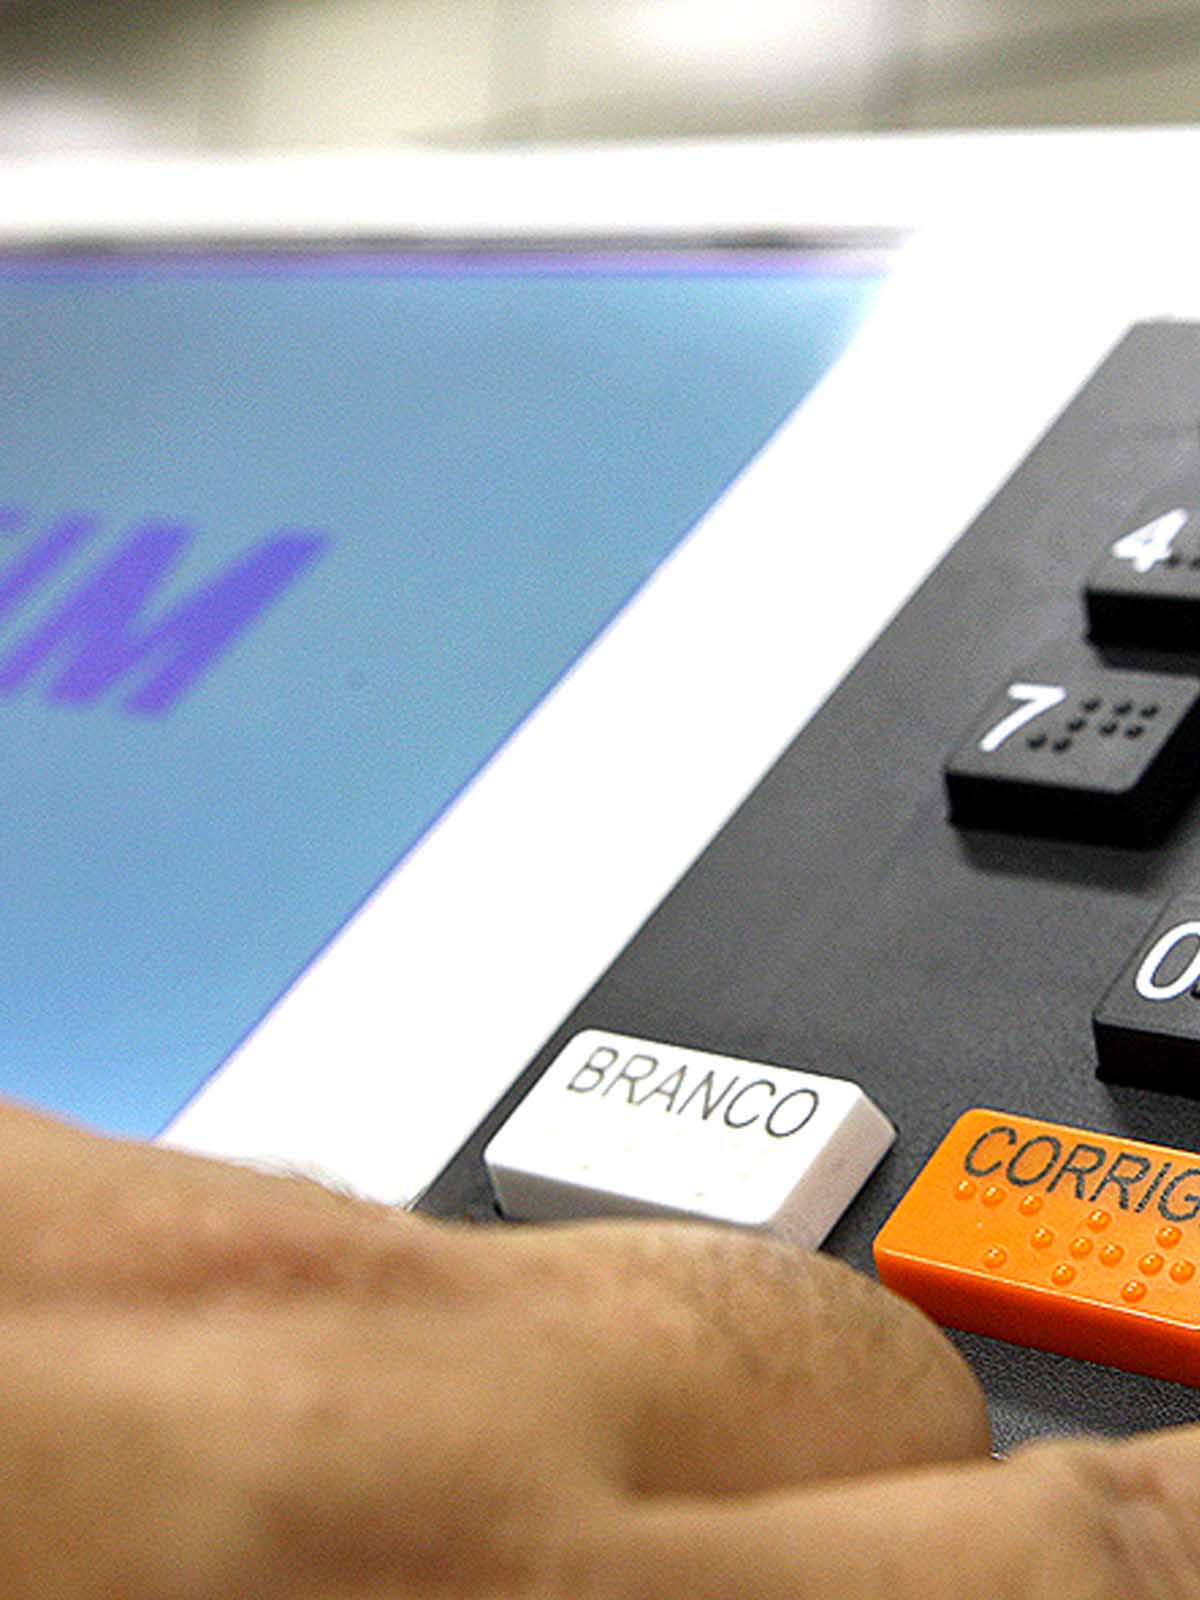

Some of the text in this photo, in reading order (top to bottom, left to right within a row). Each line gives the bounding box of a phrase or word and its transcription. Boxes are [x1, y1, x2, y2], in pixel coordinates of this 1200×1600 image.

[1112, 508, 1188, 573] 4
[0, 508, 332, 716] IM
[978, 683, 1067, 752] 7
[566, 1046, 820, 1139] BRANCO
